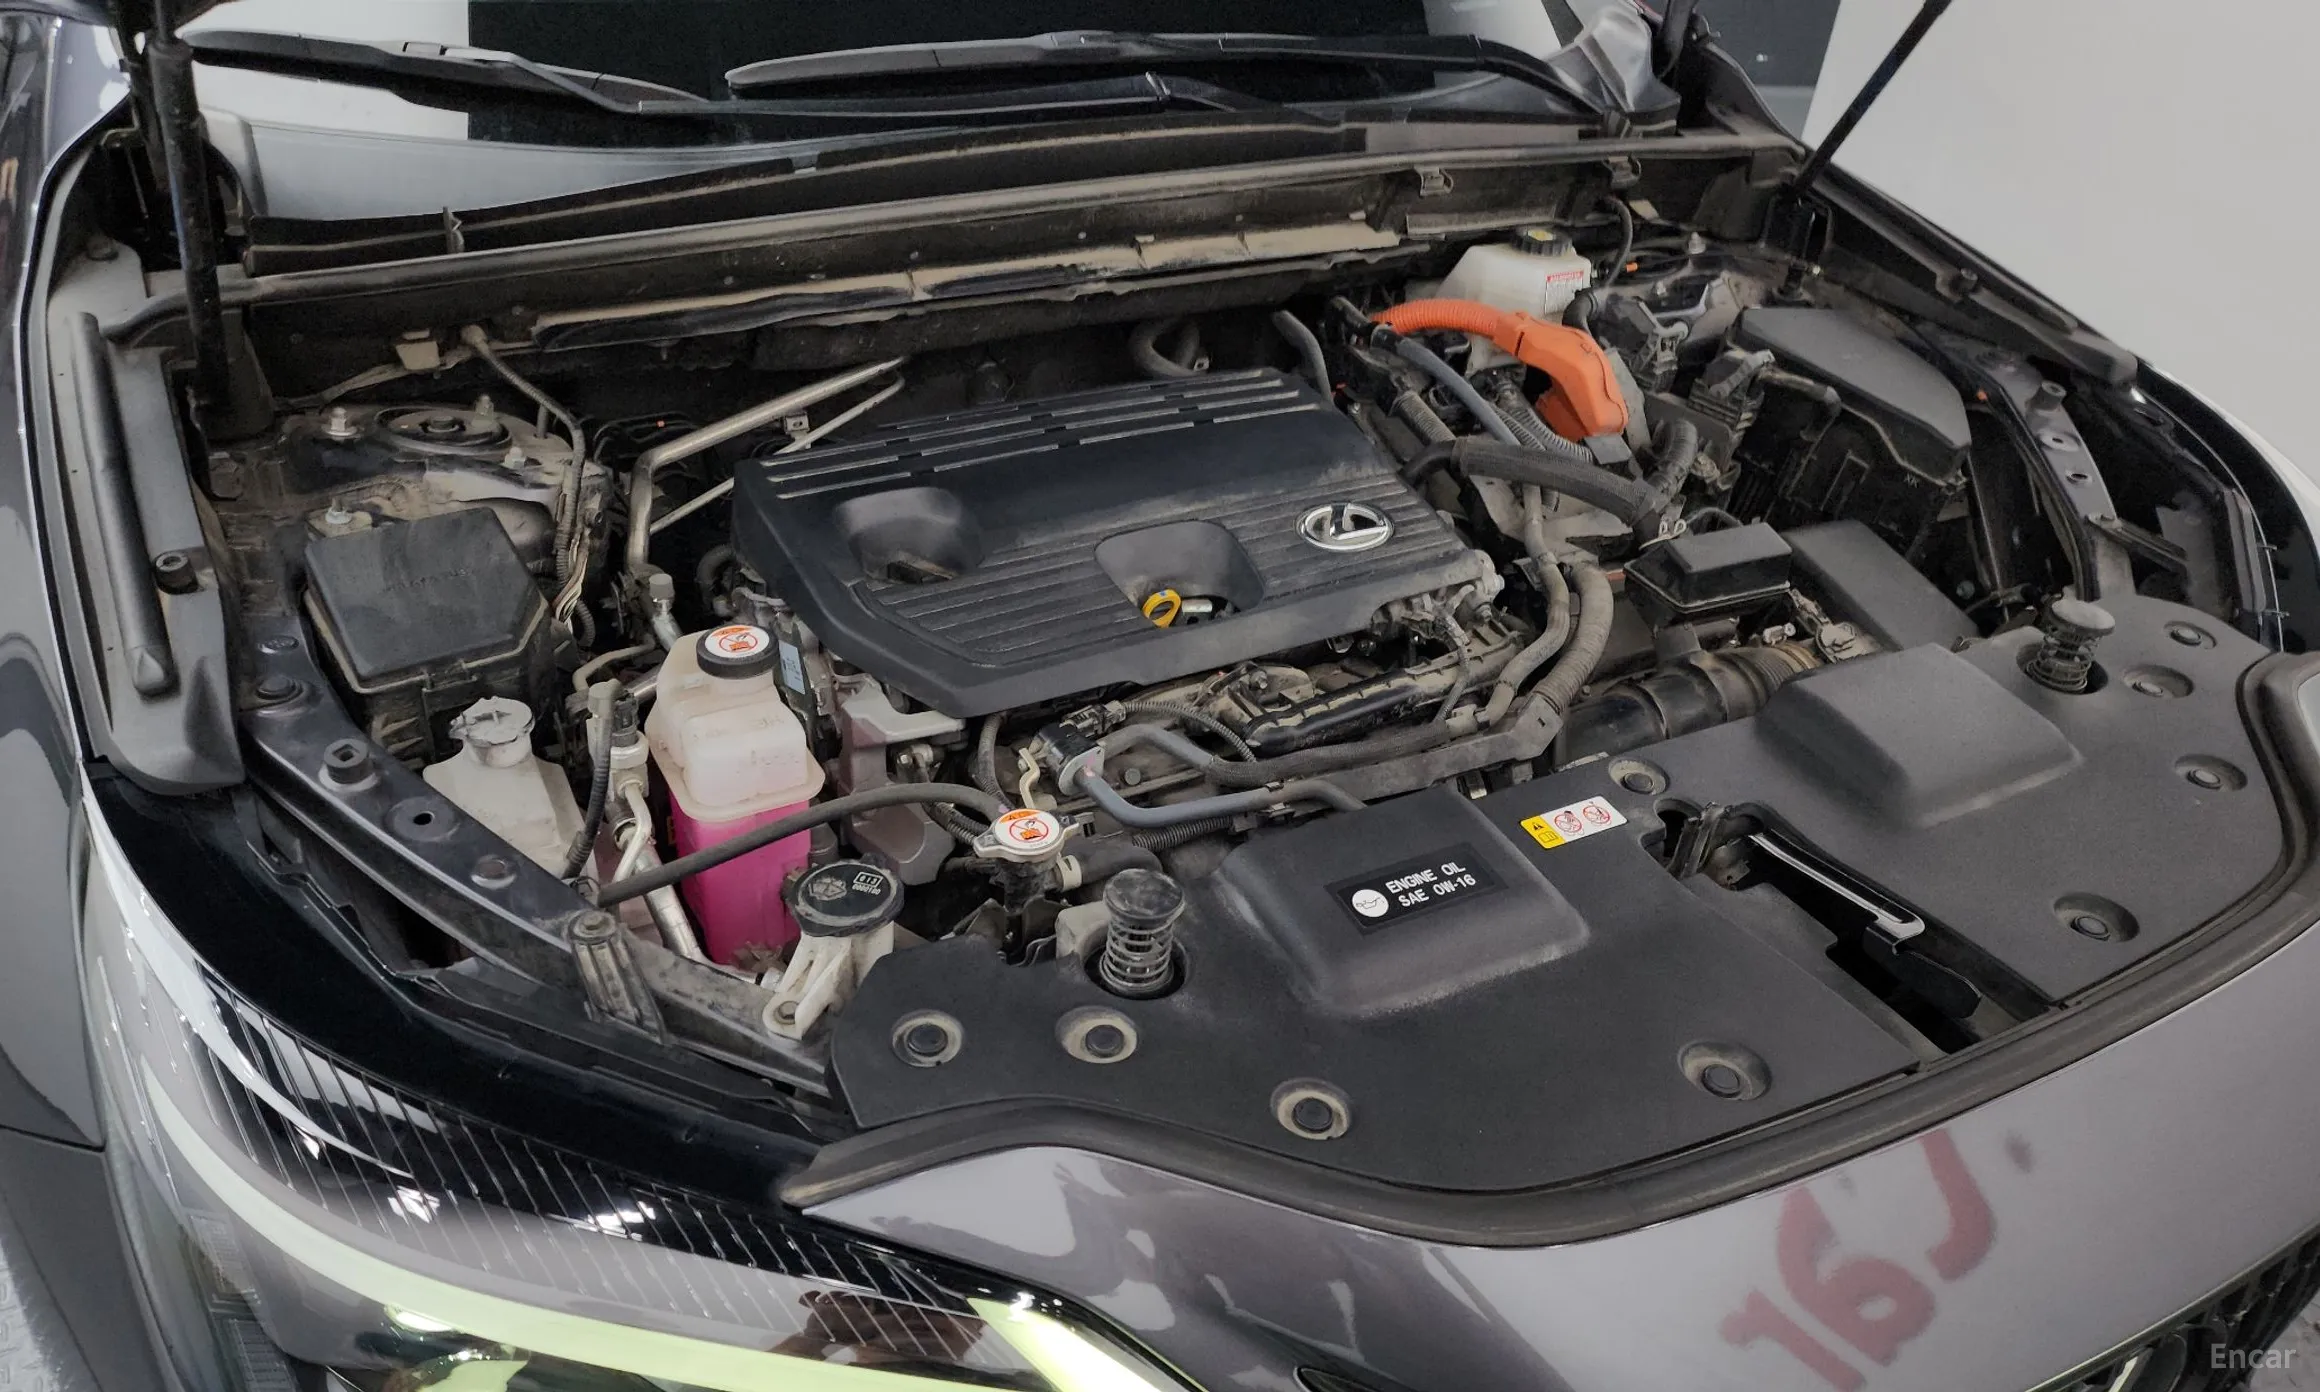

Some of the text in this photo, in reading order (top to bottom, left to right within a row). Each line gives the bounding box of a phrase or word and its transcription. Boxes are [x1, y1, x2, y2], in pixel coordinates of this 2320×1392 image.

[1385, 861, 1466, 894] ENGINE OIL
[1398, 873, 1476, 907] SAE 0W-16
